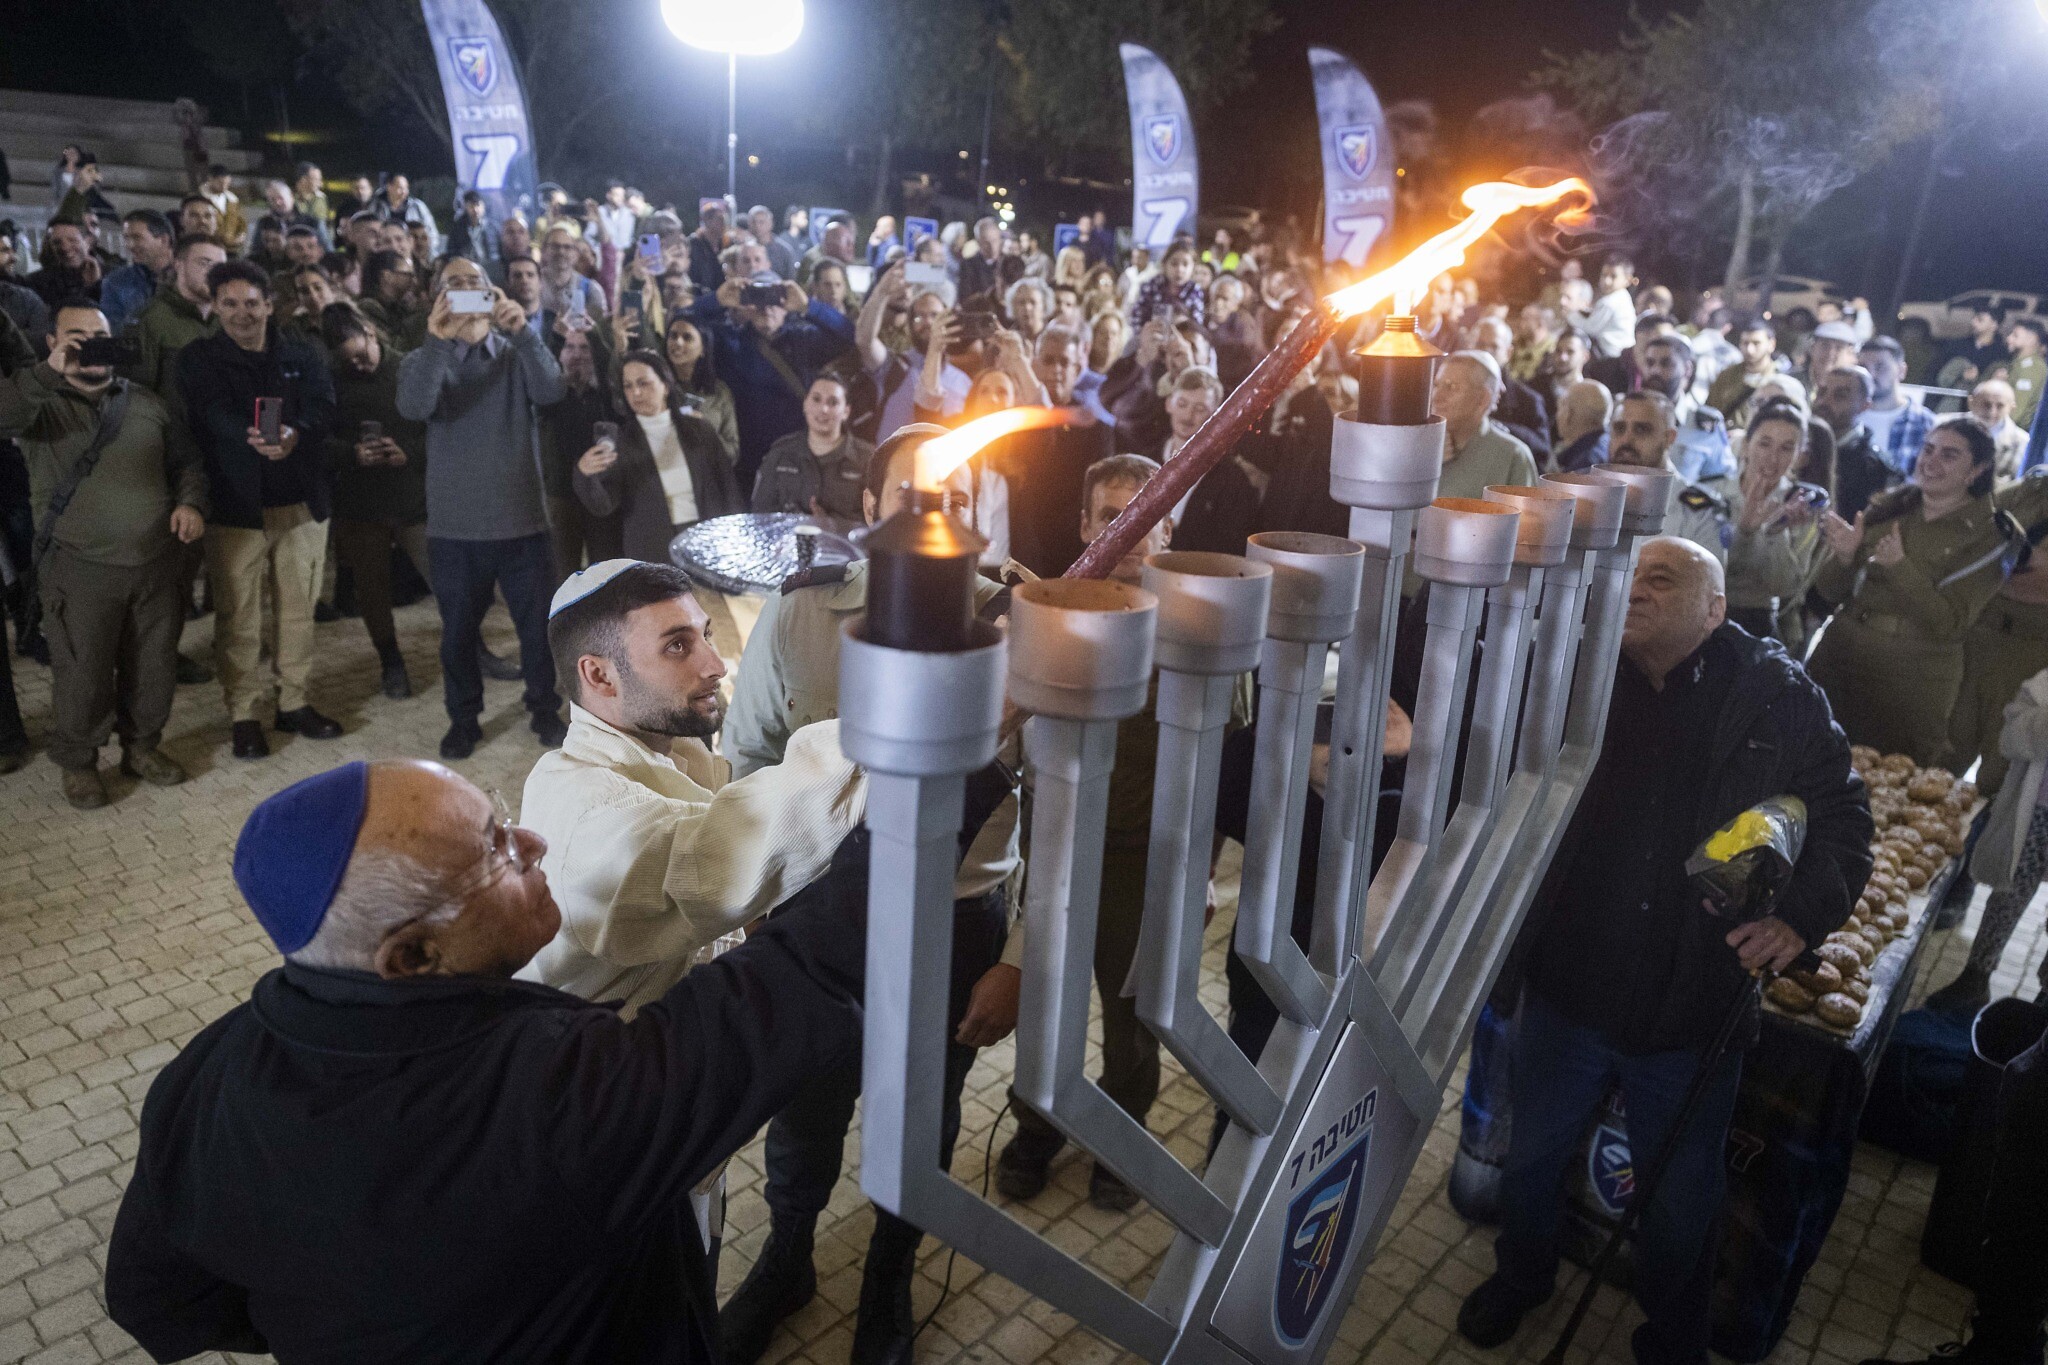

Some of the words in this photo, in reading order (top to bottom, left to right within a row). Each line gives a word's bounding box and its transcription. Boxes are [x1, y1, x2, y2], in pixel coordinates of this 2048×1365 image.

[456, 104, 519, 120] חטיבה
[462, 133, 519, 190] 7
[1142, 198, 1188, 246] 7
[1334, 216, 1385, 267] 7
[1309, 1089, 1377, 1173] חטיבה
[1730, 1128, 1766, 1173] 7
